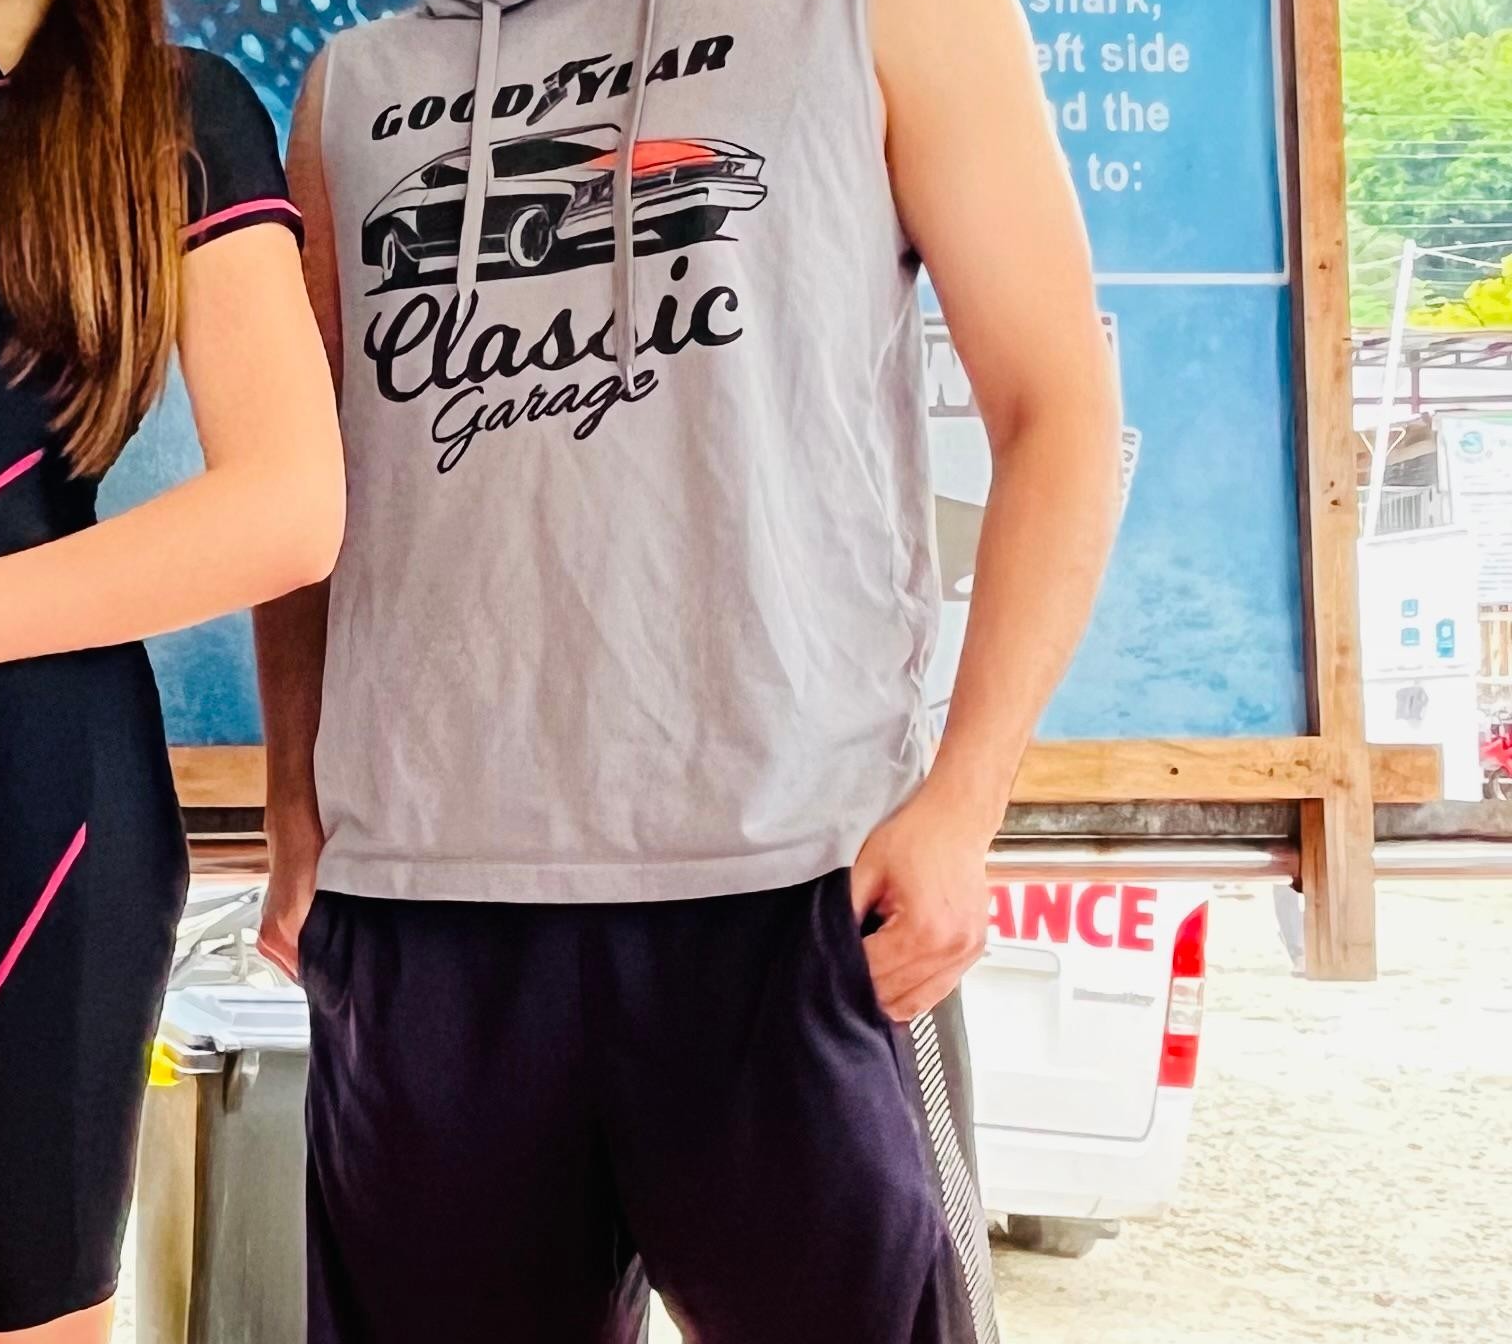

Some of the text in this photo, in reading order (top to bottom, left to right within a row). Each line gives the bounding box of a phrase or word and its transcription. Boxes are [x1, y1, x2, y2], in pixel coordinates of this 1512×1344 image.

[1034, 32, 1189, 73] eft side
[1103, 91, 1169, 131] the
[1088, 152, 1141, 192] to:
[432, 369, 659, 473] Garage
